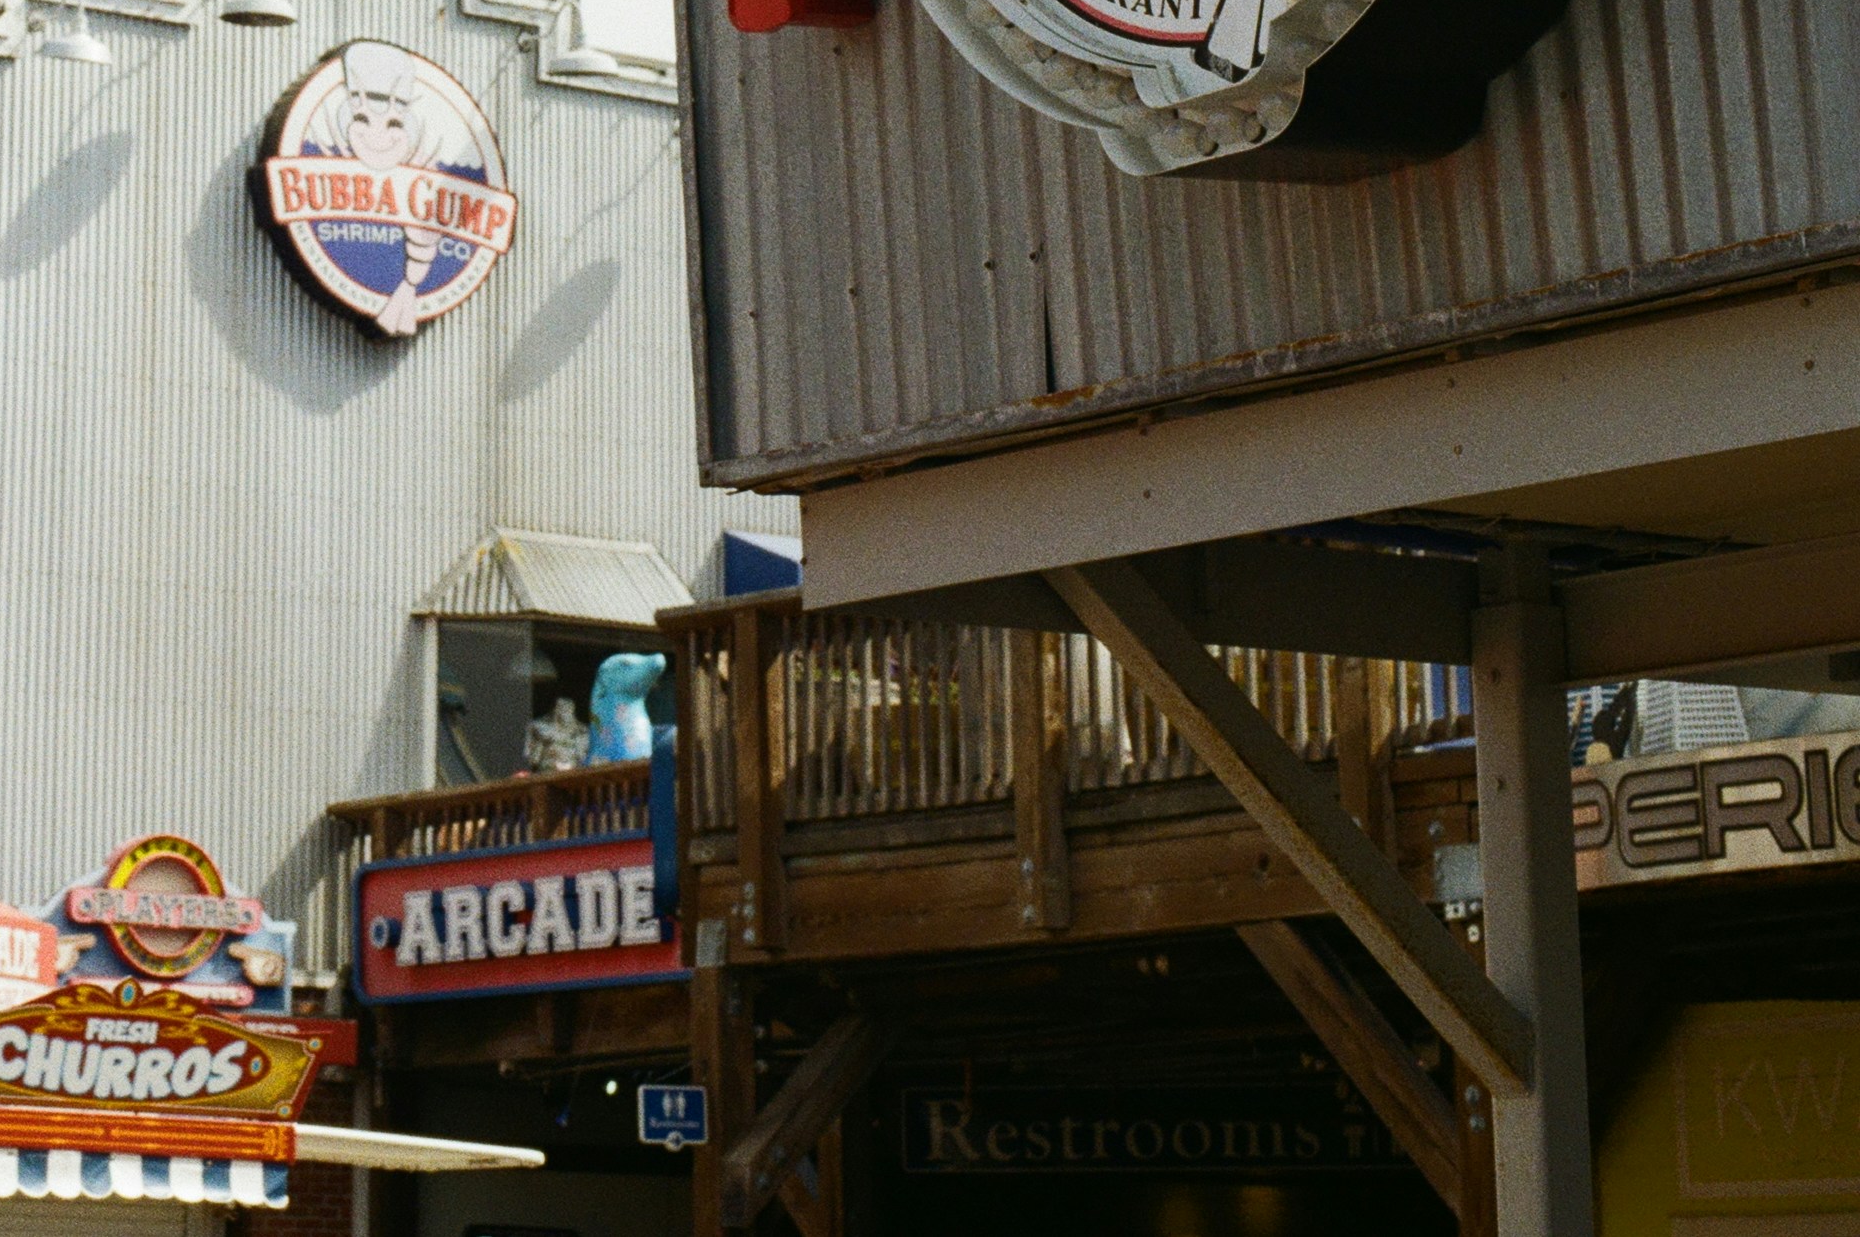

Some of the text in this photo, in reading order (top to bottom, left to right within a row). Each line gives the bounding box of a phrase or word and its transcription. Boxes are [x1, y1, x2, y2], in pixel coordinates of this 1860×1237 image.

[278, 166, 508, 241] BUBBA GUMP
[317, 222, 472, 261] SHRIMP CO
[95, 891, 240, 930] PLAYERS
[395, 866, 662, 966] ARCADE
[86, 1017, 159, 1044] FRESH
[922, 1096, 1323, 1163] Restrooms
